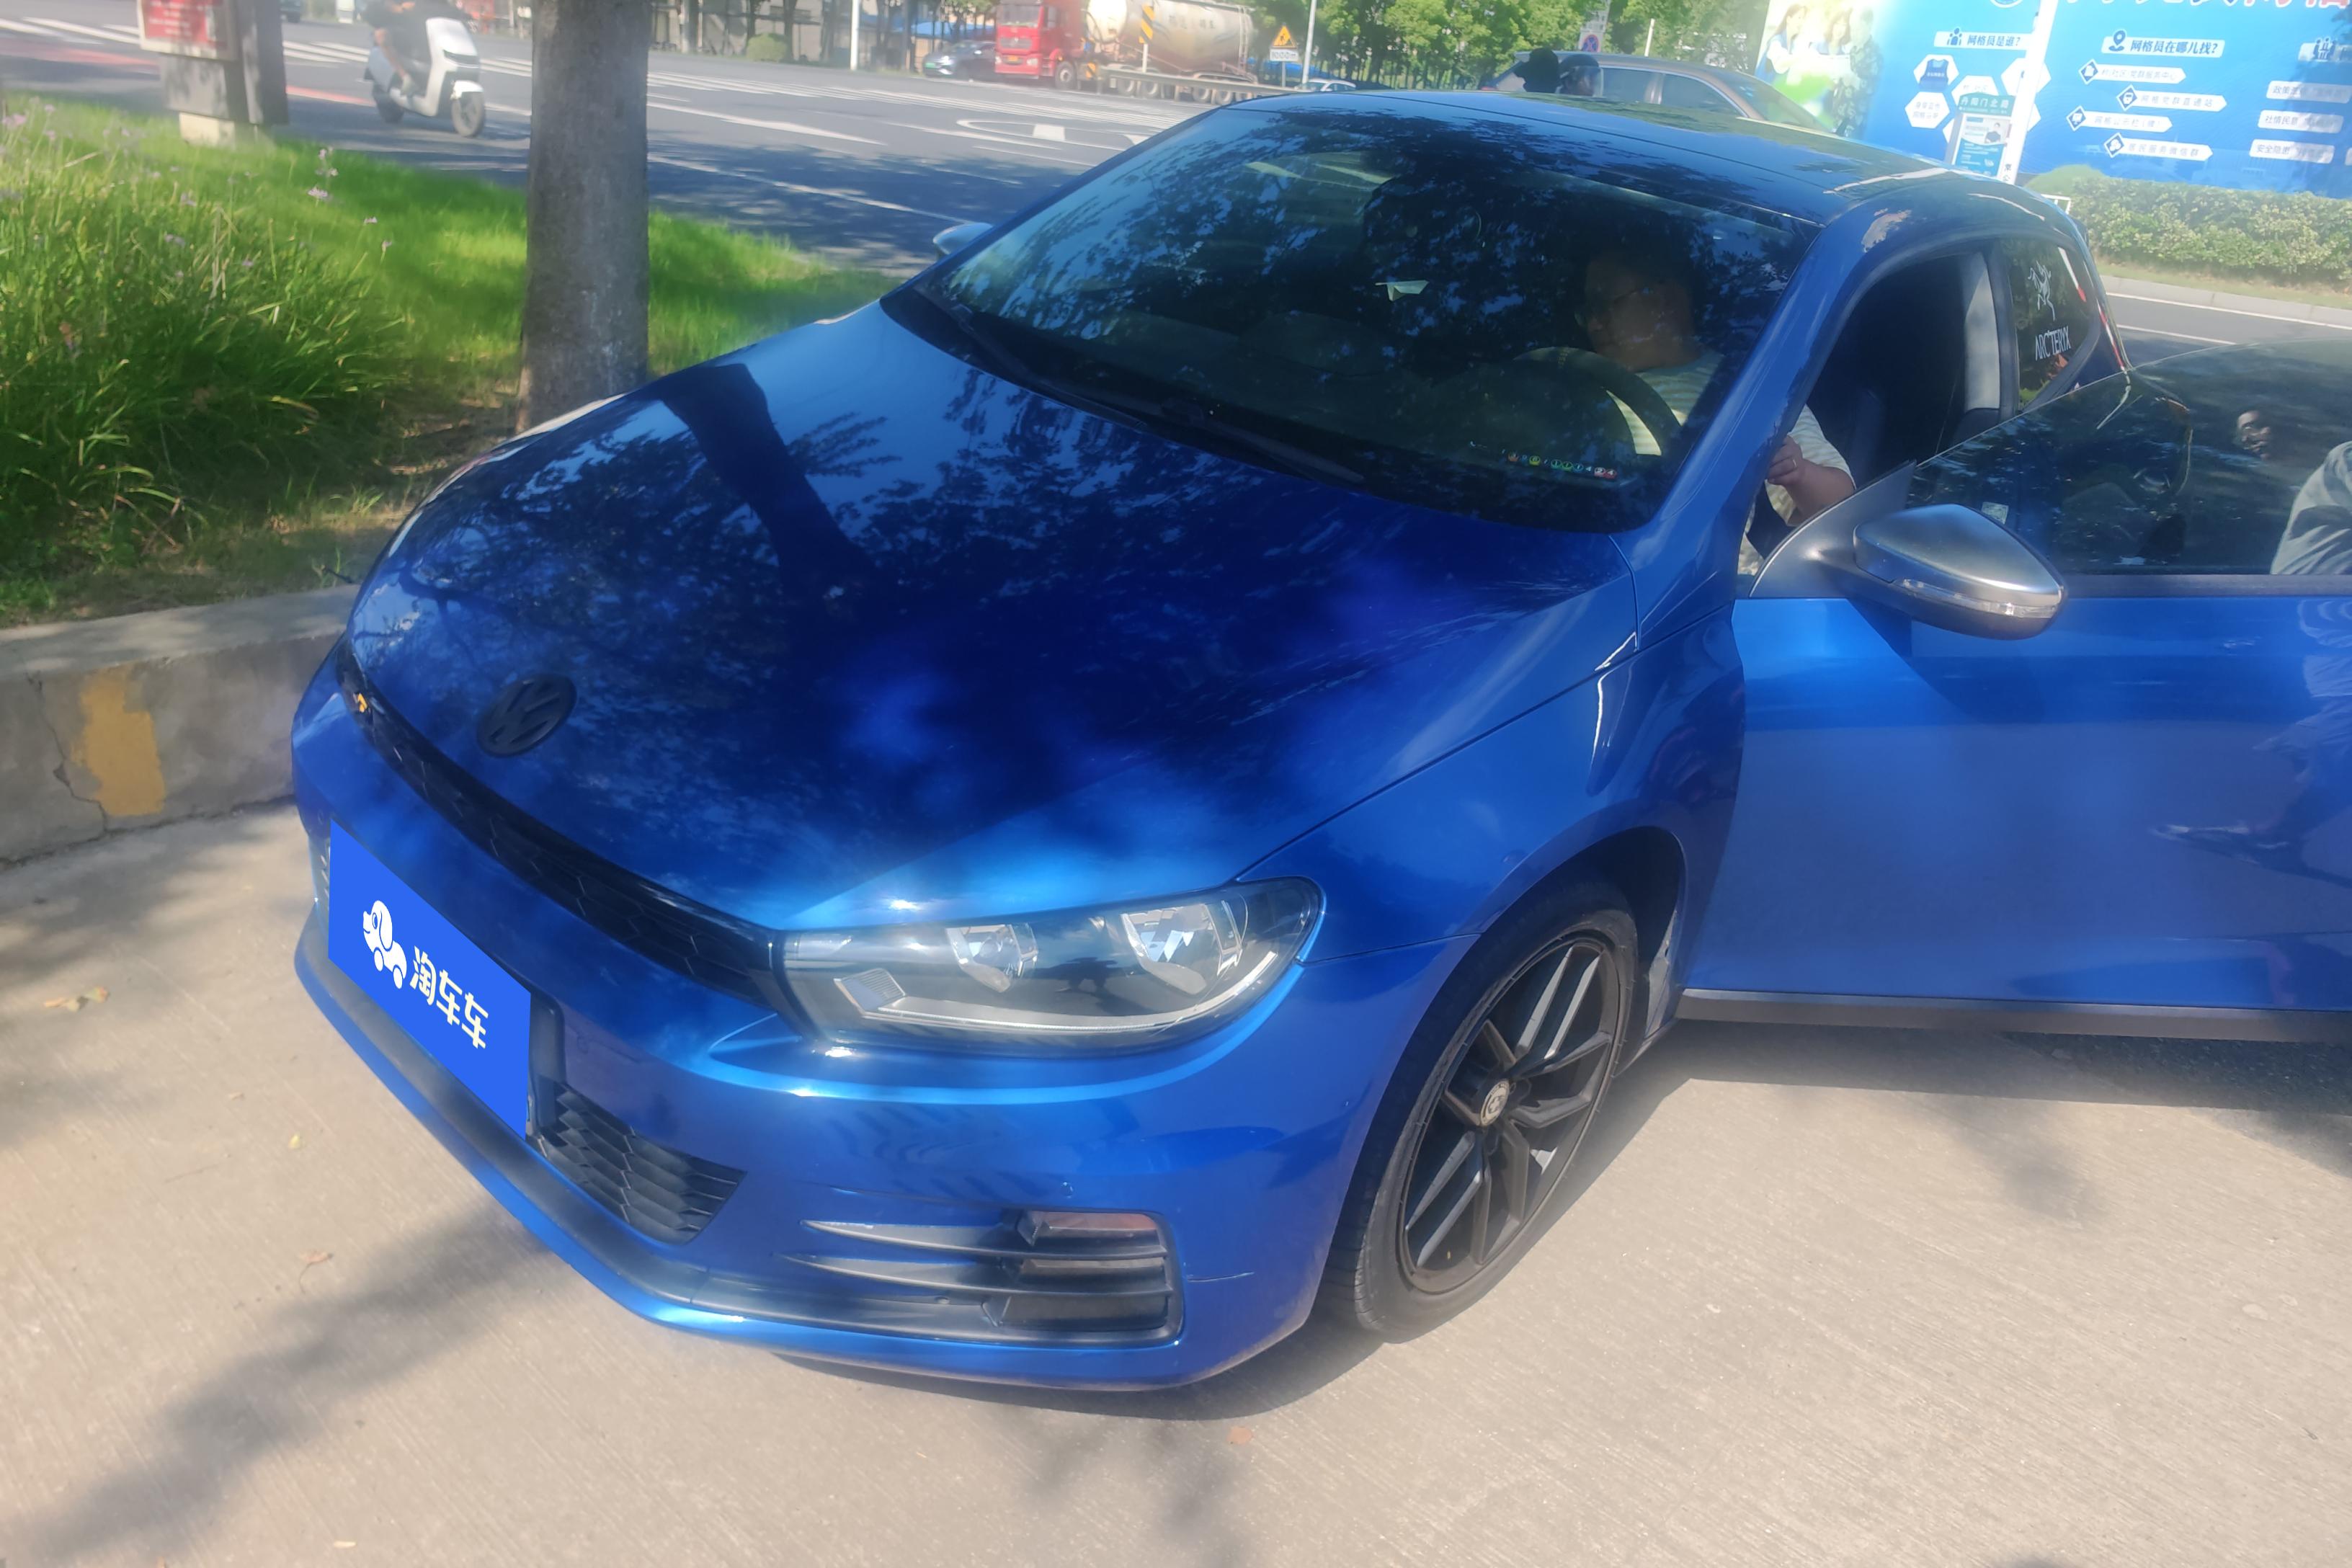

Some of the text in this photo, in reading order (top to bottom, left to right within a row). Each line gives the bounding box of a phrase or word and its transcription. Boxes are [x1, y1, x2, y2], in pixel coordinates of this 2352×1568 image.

[2130, 40, 2218, 54] 网格员在哪儿找？
